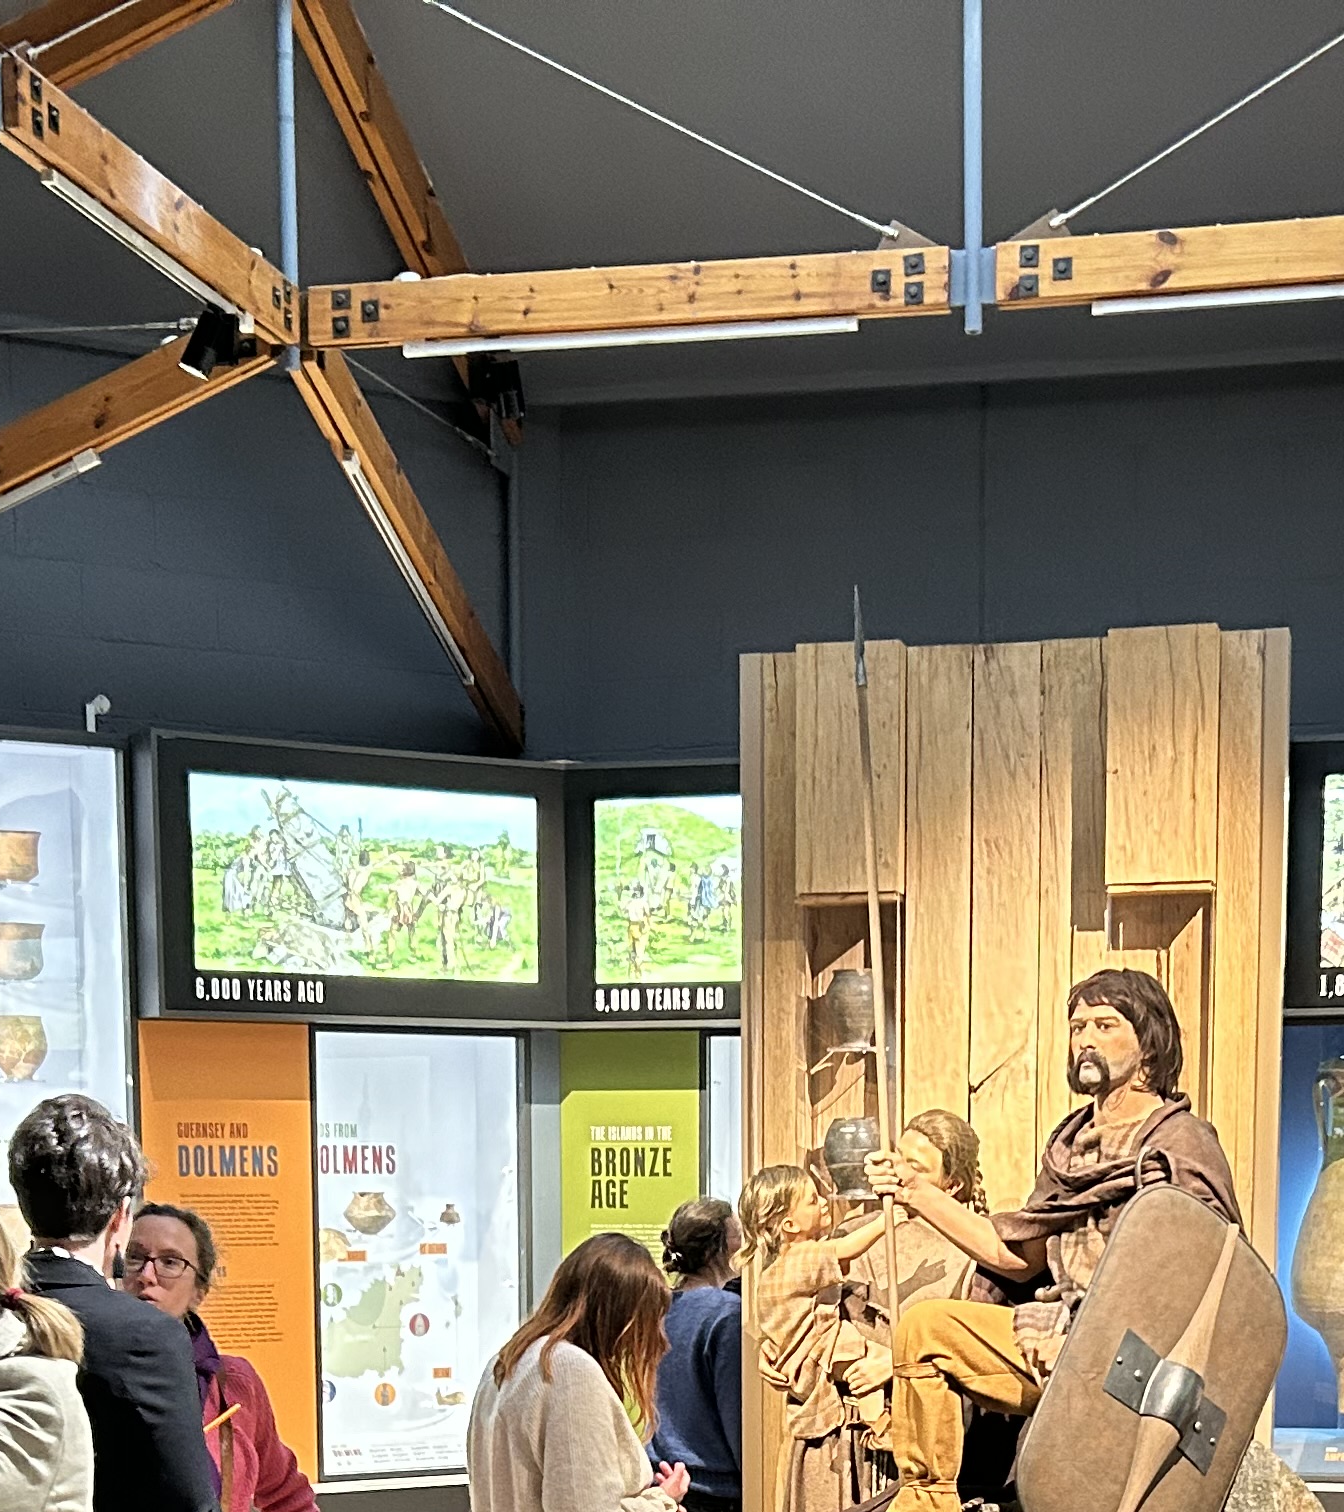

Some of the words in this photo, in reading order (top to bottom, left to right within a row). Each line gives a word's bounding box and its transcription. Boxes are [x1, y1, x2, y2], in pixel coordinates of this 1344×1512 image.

[195, 977, 241, 1001] 6,000
[247, 978, 291, 1003] YEARS
[298, 981, 324, 1003] AGO
[646, 987, 690, 1011] YEARS
[696, 986, 724, 1010] AGO
[176, 1122, 225, 1139] GUERNSEY
[229, 1122, 249, 1139] AND
[334, 1123, 358, 1138] FROM
[177, 1145, 279, 1178] DOLMENS
[320, 1144, 396, 1175] OLMENS
[590, 1147, 672, 1177] BRONZE
[590, 1179, 628, 1209] AGE
